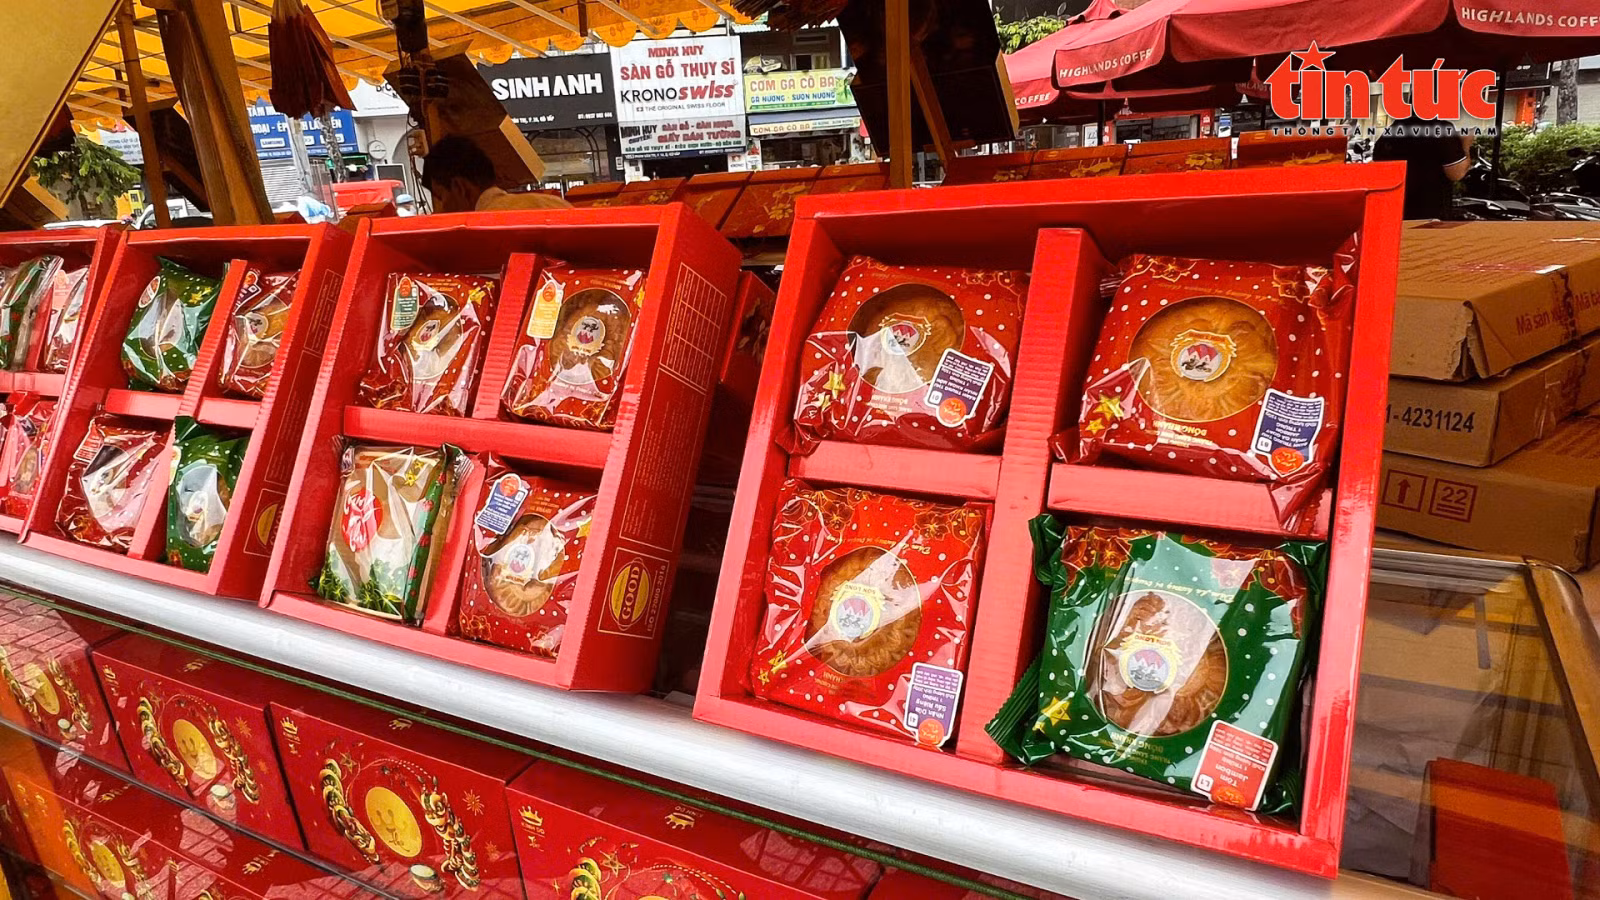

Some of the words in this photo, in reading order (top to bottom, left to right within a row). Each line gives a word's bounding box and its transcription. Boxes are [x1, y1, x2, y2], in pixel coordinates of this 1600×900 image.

[1462, 7, 1554, 26] HIGHLANDS
[1558, 16, 1600, 27] COFF
[648, 47, 679, 58] MINH
[681, 45, 704, 56] HUY
[620, 64, 651, 81] SÀN
[656, 59, 674, 78] GỖ
[681, 62, 717, 79] THỤY
[1059, 59, 1118, 78] HIGHLANDS
[491, 76, 551, 100] SINH
[553, 73, 603, 96] ANH
[819, 76, 835, 88] BA
[657, 103, 686, 111] ORIGINAL
[686, 102, 705, 110] SWISS
[1014, 93, 1050, 106] COFFEE
[620, 125, 640, 138] MINH
[642, 124, 657, 135] HUY
[1441, 486, 1466, 504] 22
[621, 566, 641, 621] GOOD
[1213, 763, 1249, 782] Jambon
